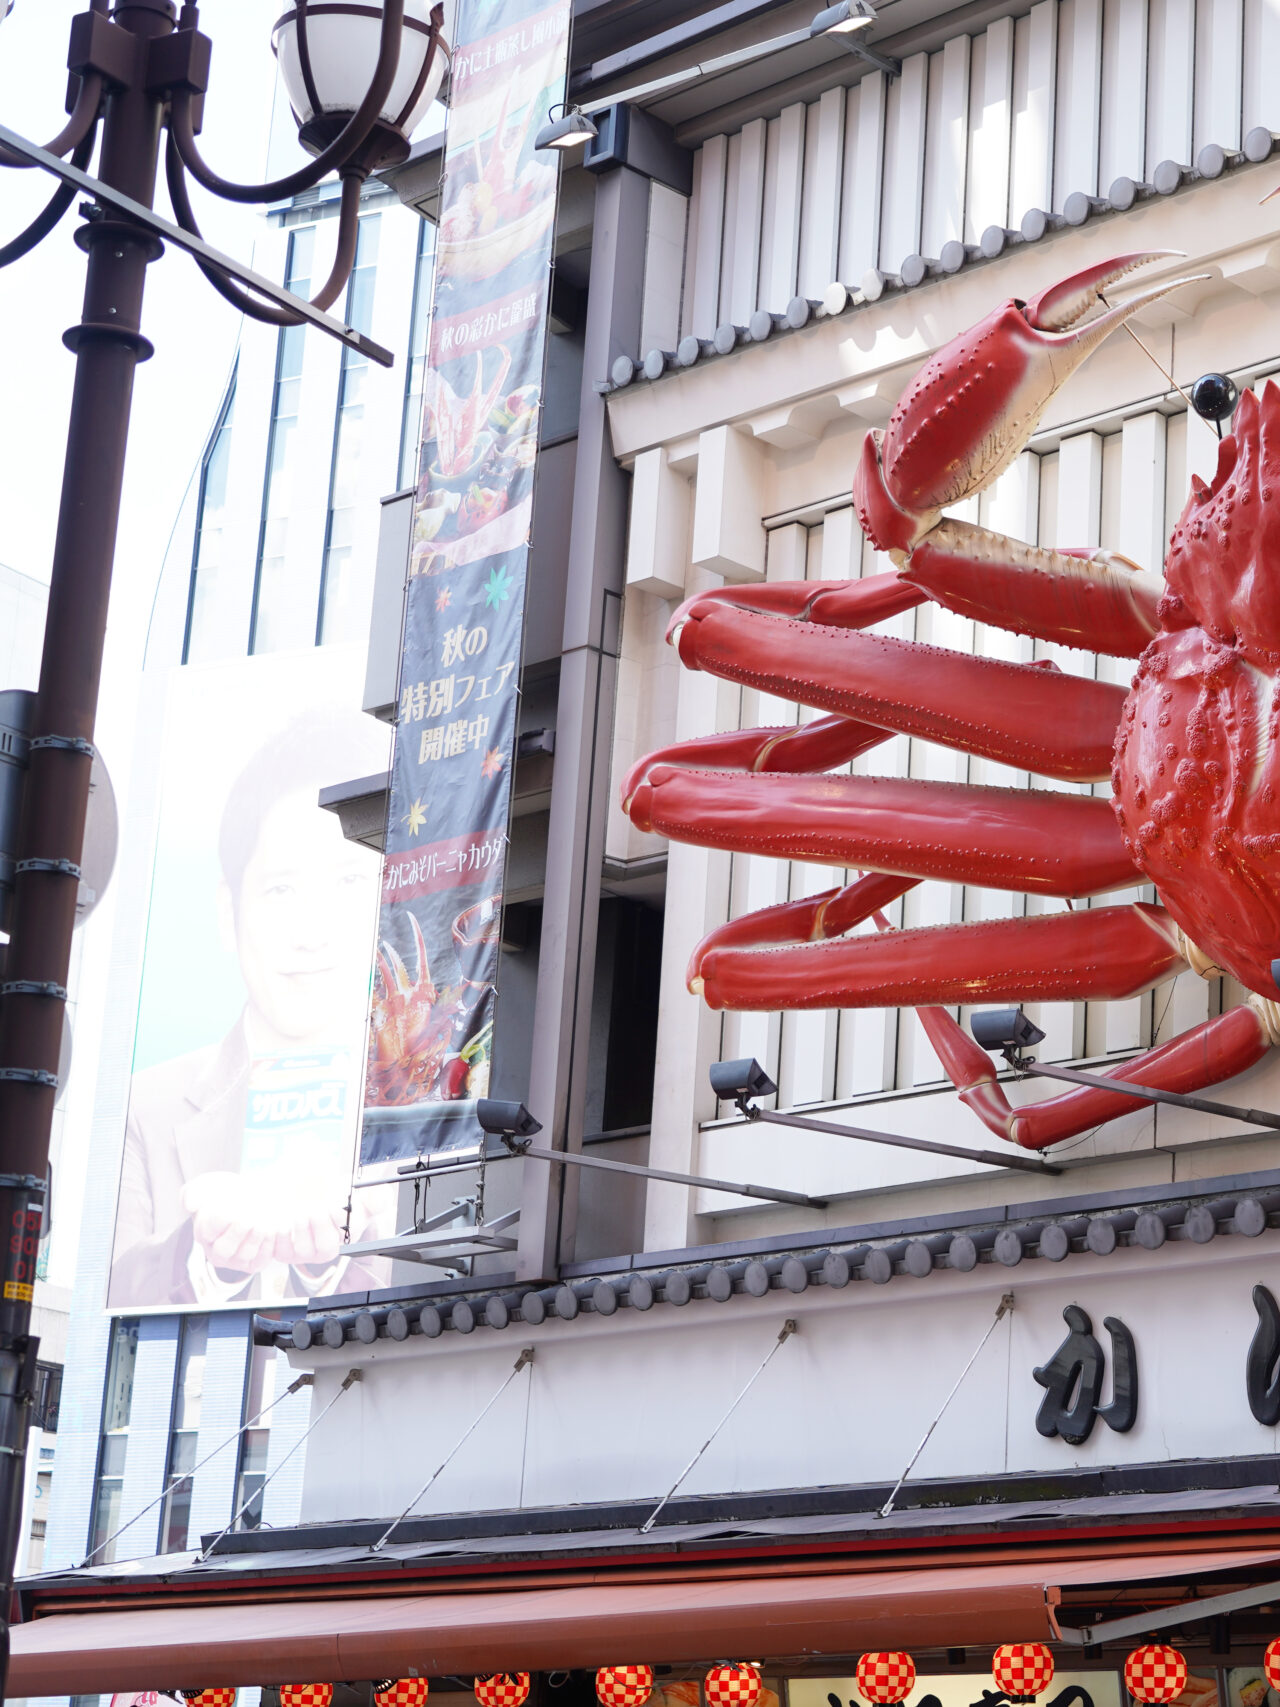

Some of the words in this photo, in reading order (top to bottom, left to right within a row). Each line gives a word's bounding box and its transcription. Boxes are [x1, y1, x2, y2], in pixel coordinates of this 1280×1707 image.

[441, 624, 488, 668] 秋の
[401, 661, 516, 725] 特別フェア
[418, 713, 490, 765] 開催中
[386, 838, 502, 890] かにみそバーニャカウダ
